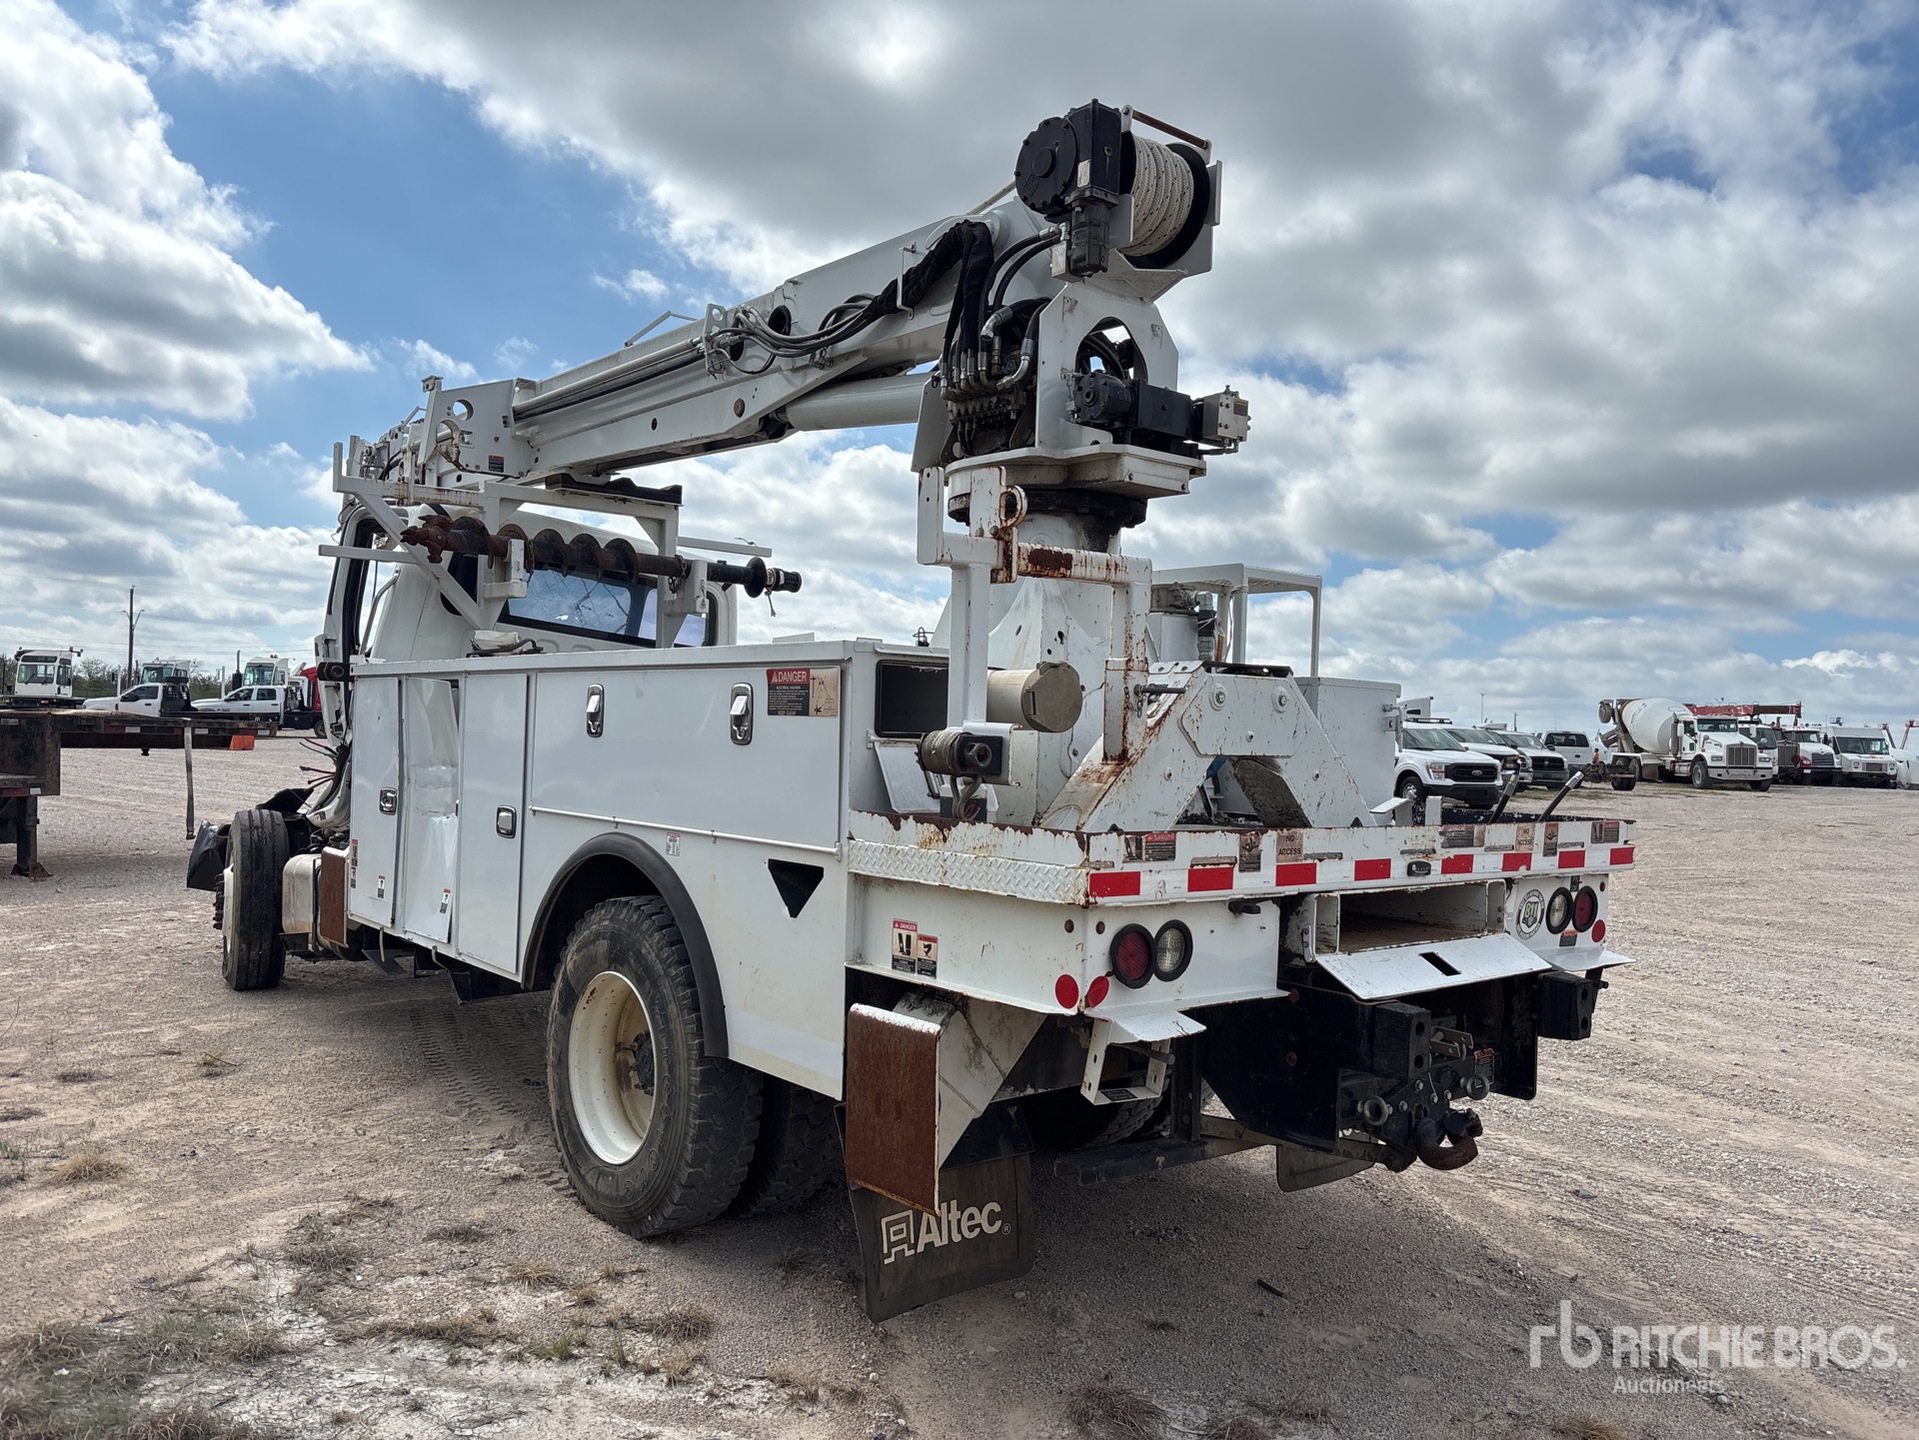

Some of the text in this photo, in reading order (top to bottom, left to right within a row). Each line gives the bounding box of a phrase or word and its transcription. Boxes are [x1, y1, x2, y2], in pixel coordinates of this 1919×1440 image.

[778, 671, 807, 682] DANGER
[1285, 834, 1295, 842] NO
[1278, 847, 1301, 855] ACCESS
[1524, 901, 1539, 918] 811
